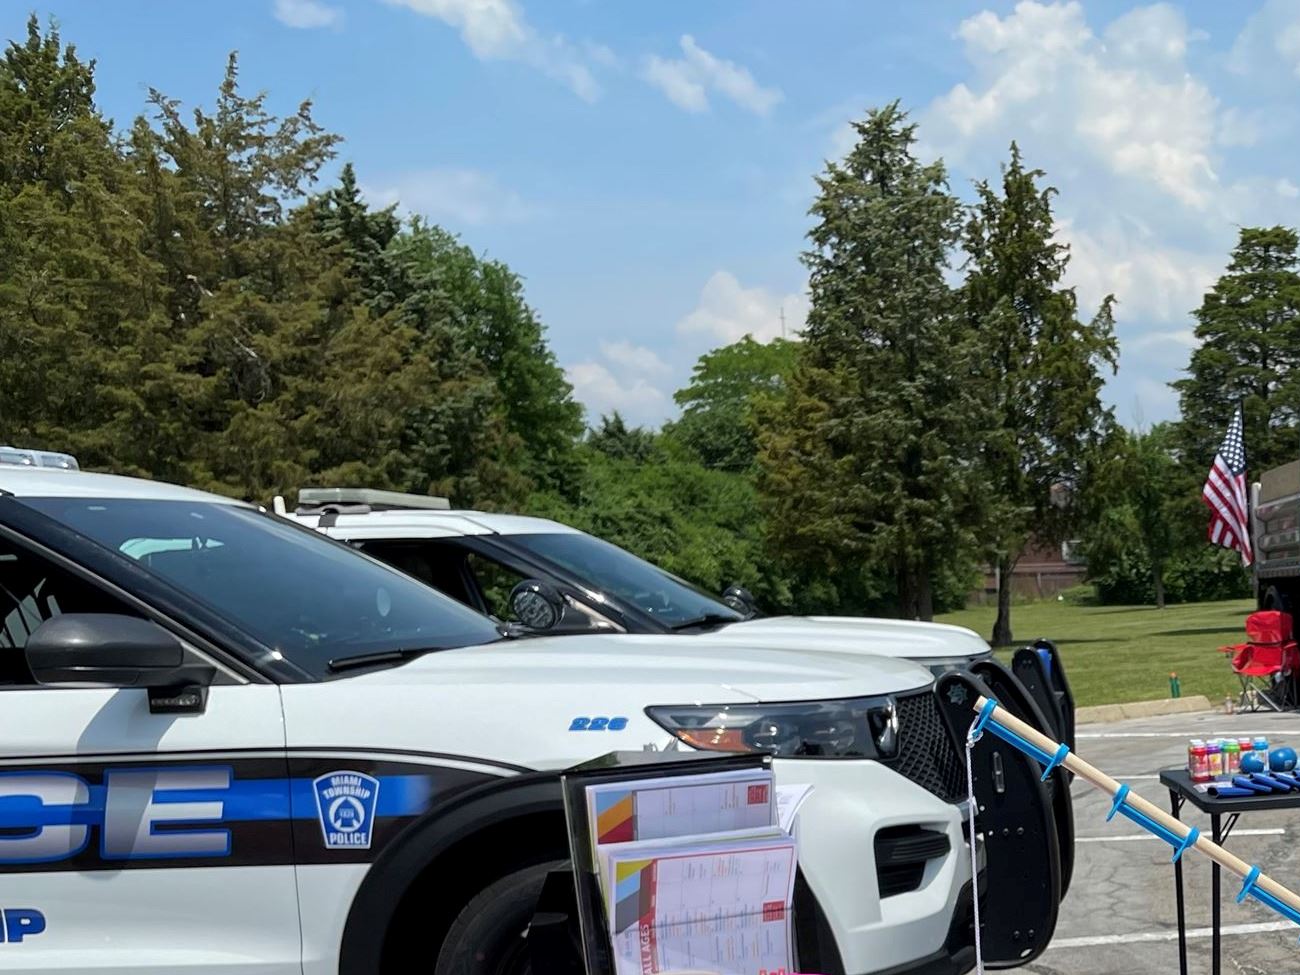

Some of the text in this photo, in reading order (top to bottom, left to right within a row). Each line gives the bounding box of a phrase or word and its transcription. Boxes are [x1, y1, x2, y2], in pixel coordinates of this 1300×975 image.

[331, 775, 362, 787] MIAMI
[323, 786, 371, 800] TOWNSHIP
[329, 832, 368, 845] POLICE
[640, 924, 651, 952] AGES
